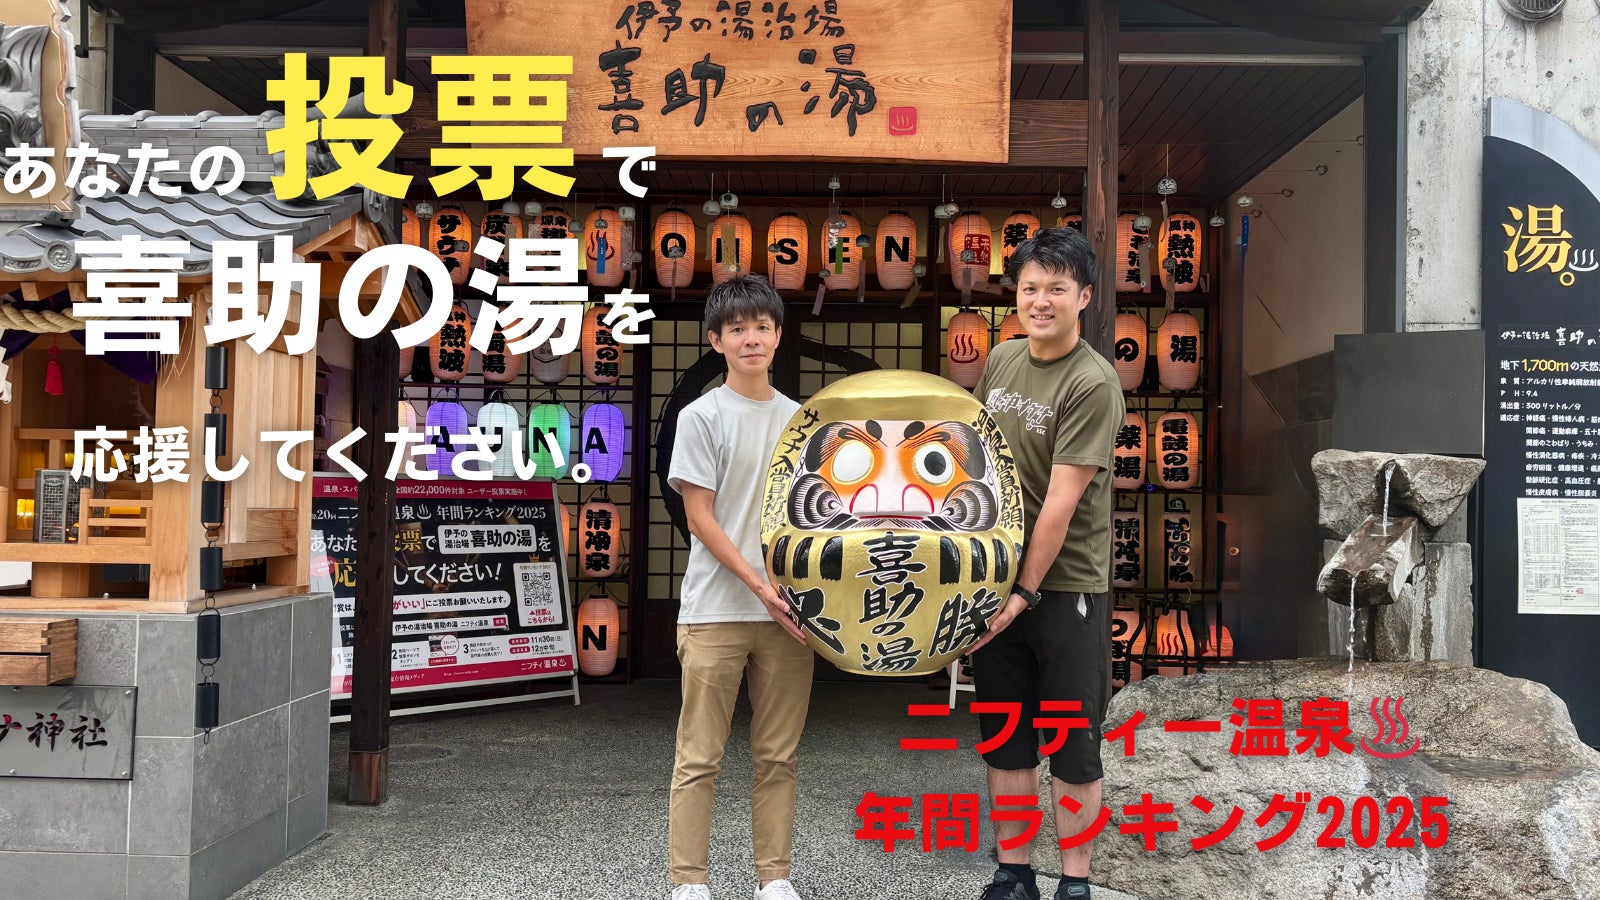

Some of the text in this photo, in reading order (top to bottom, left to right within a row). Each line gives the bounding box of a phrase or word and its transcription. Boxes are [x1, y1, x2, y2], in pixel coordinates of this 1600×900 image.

[615, 0, 845, 42] 伊予の湯治場
[598, 40, 877, 137] 喜助の湯
[1555, 326, 1600, 347] 喜助の
[1500, 358, 1600, 373] 地下1,700mの天然
[1161, 418, 1190, 483] 電鼓の湯
[436, 504, 547, 521] 年間ランキング2025
[444, 529, 468, 538] 伊予の
[469, 529, 533, 548] 喜助の湯
[538, 535, 551, 552] を
[585, 509, 612, 572] 清冷泉
[856, 530, 928, 672] 喜助の湯
[463, 643, 469, 654] 3
[582, 624, 607, 651] N
[391, 649, 398, 660] 2
